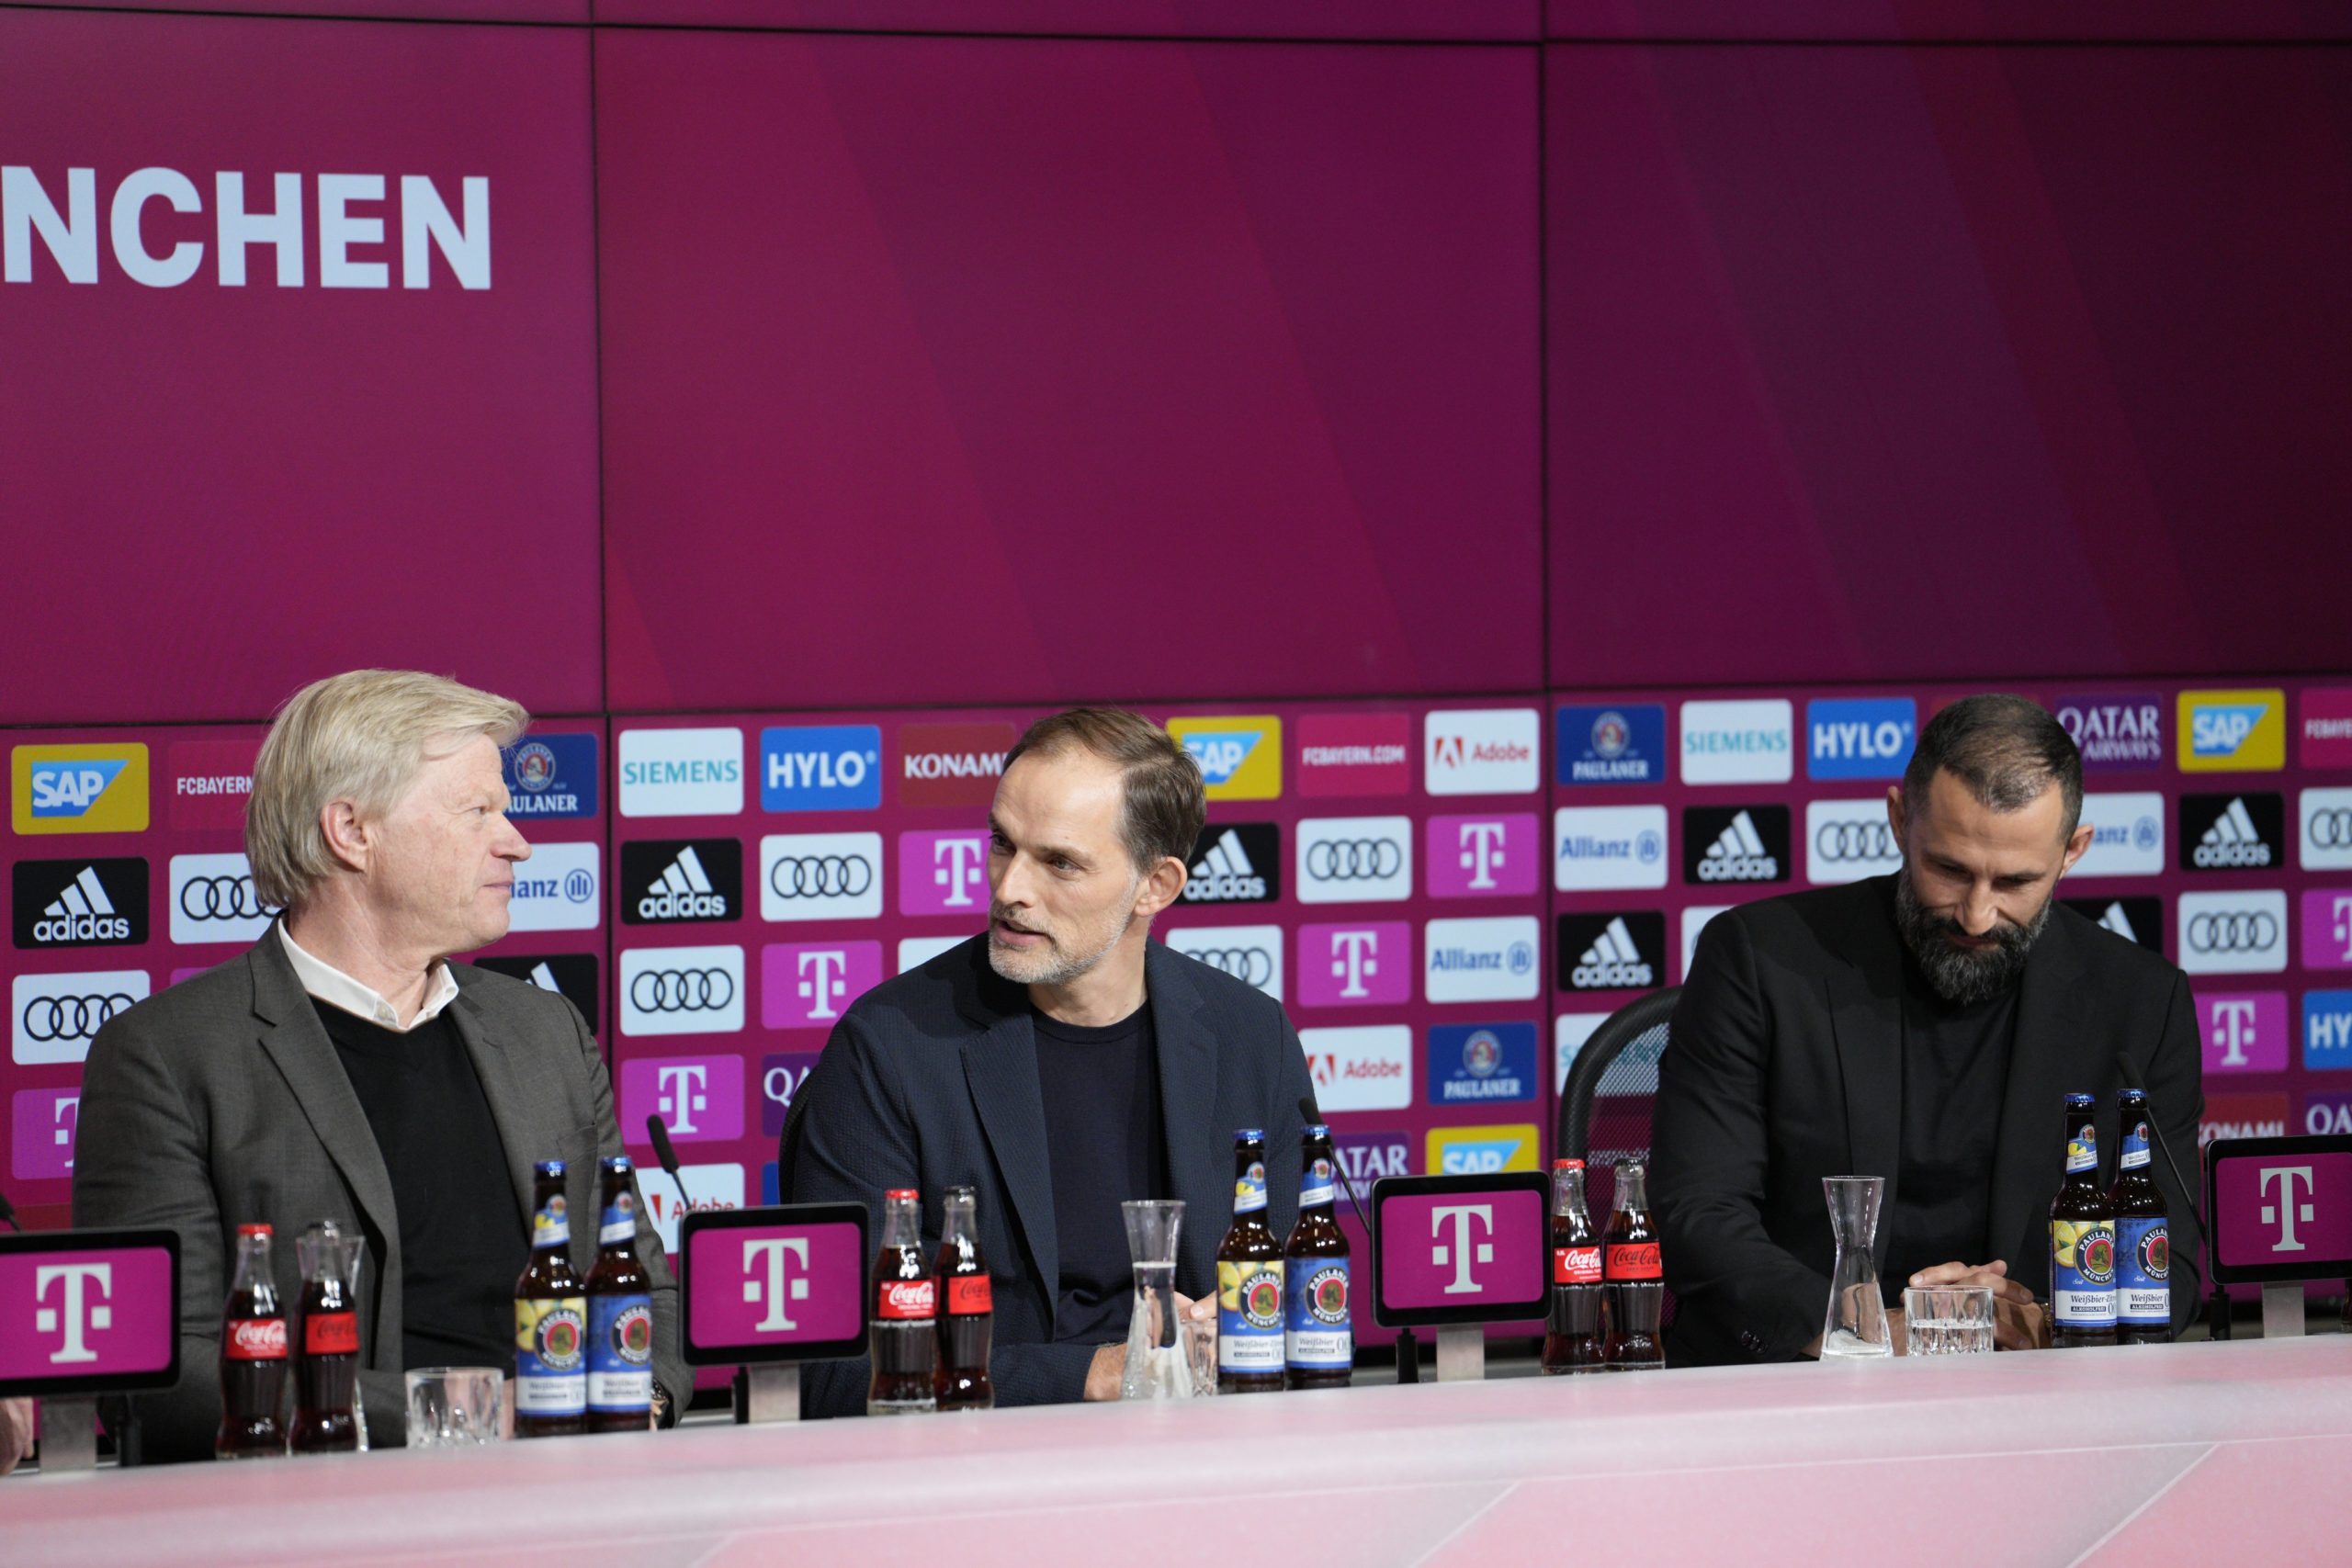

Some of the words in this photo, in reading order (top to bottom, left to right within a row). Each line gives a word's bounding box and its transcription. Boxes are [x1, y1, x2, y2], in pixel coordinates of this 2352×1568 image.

[1, 165, 492, 290] NCHEN
[2058, 705, 2160, 746] QATAR
[2193, 713, 2249, 748] SAP
[1302, 745, 1406, 765] FCBAYERN.COM
[1472, 743, 1530, 761] Adobe
[1685, 730, 1788, 754] SIEMENS
[2083, 739, 2161, 761] AIRWAYS
[623, 760, 739, 784] SIEMENS
[904, 752, 1008, 779] KONAM
[1572, 761, 1649, 780] PAULANER
[32, 771, 104, 807] SAP
[1460, 822, 1505, 888] T
[1560, 837, 1630, 859] Allianz
[2193, 842, 2271, 867] adidas
[934, 839, 981, 906] T
[1697, 856, 1778, 881] adidas
[511, 879, 559, 898] ianz
[1182, 875, 1266, 901] adidas
[639, 890, 726, 919] adidas
[33, 917, 130, 942] adidas
[1331, 931, 1377, 998] T
[1430, 948, 1501, 971] Allianz
[798, 951, 845, 1019] T
[1571, 963, 1653, 988] adidas
[2211, 1000, 2256, 1066] T
[1343, 1059, 1403, 1078] Adobe
[659, 1066, 707, 1134] T
[1443, 1078, 1521, 1099] PAULANER
[1331, 1145, 1408, 1178] ATAR
[2260, 1166, 2314, 1252] T
[1431, 1204, 1493, 1293] T
[743, 1237, 808, 1332] T
[37, 1262, 111, 1363] T
